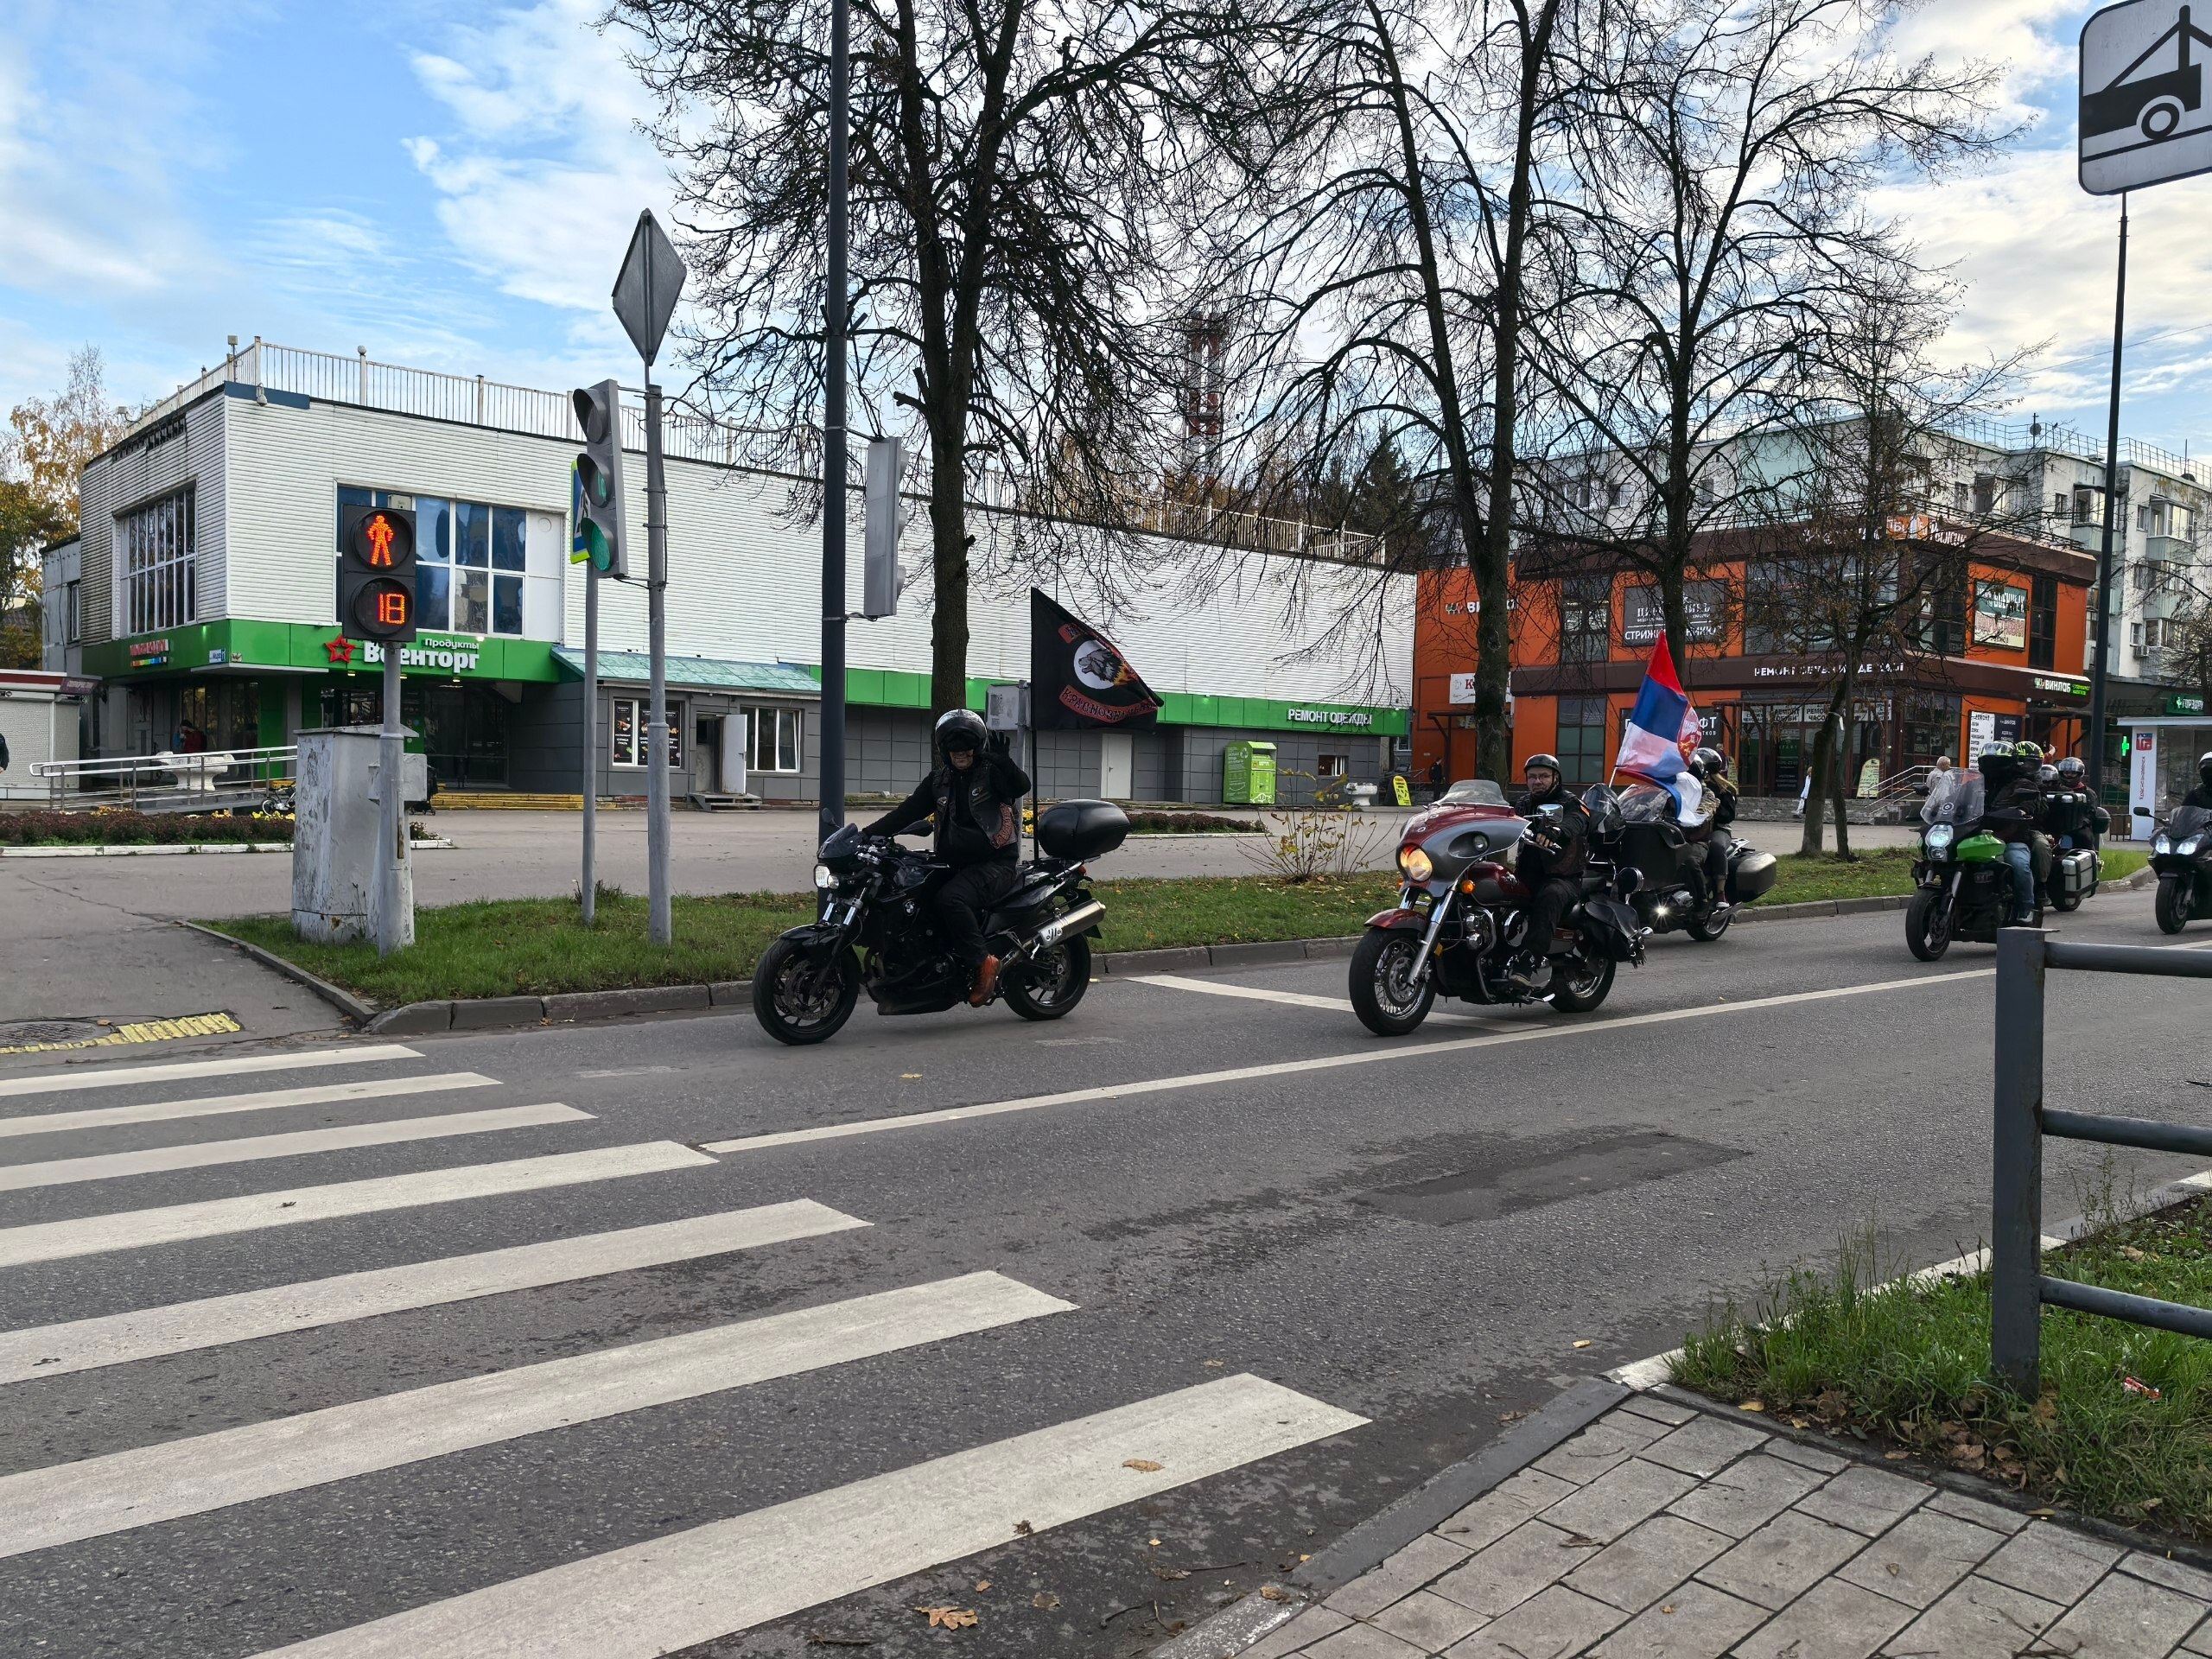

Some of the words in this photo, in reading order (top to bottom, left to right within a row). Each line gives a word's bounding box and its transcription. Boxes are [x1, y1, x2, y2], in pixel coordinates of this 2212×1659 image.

[378, 593, 406, 624] 18
[424, 638, 480, 650] Продукты
[364, 640, 480, 674] Венторг
[1287, 708, 1330, 723] РЕМОНТ
[1330, 711, 1373, 727] ОДЕЖДЫ
